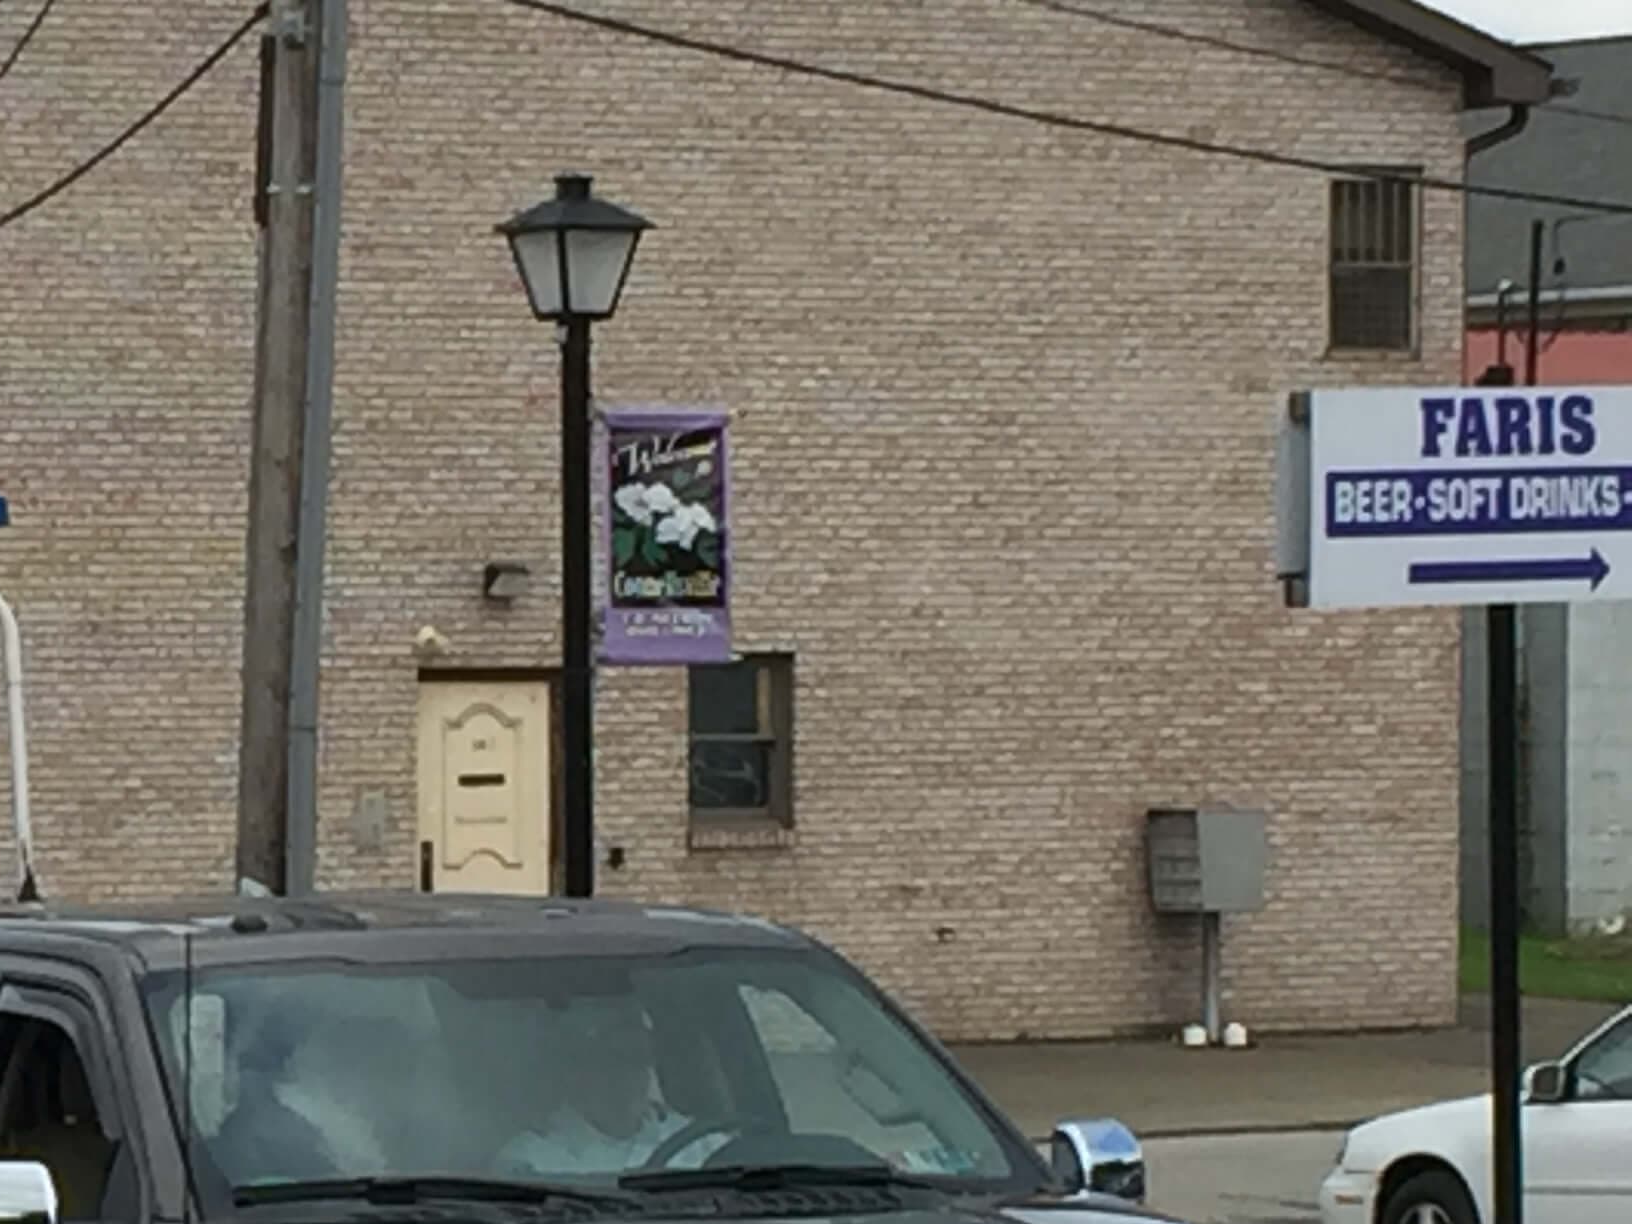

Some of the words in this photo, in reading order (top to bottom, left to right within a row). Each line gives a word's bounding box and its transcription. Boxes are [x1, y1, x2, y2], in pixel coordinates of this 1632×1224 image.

[1419, 395, 1596, 457] FARIS
[1333, 479, 1412, 523] BEER
[1426, 476, 1502, 521] SOFT
[1509, 475, 1621, 519] DRINKS
